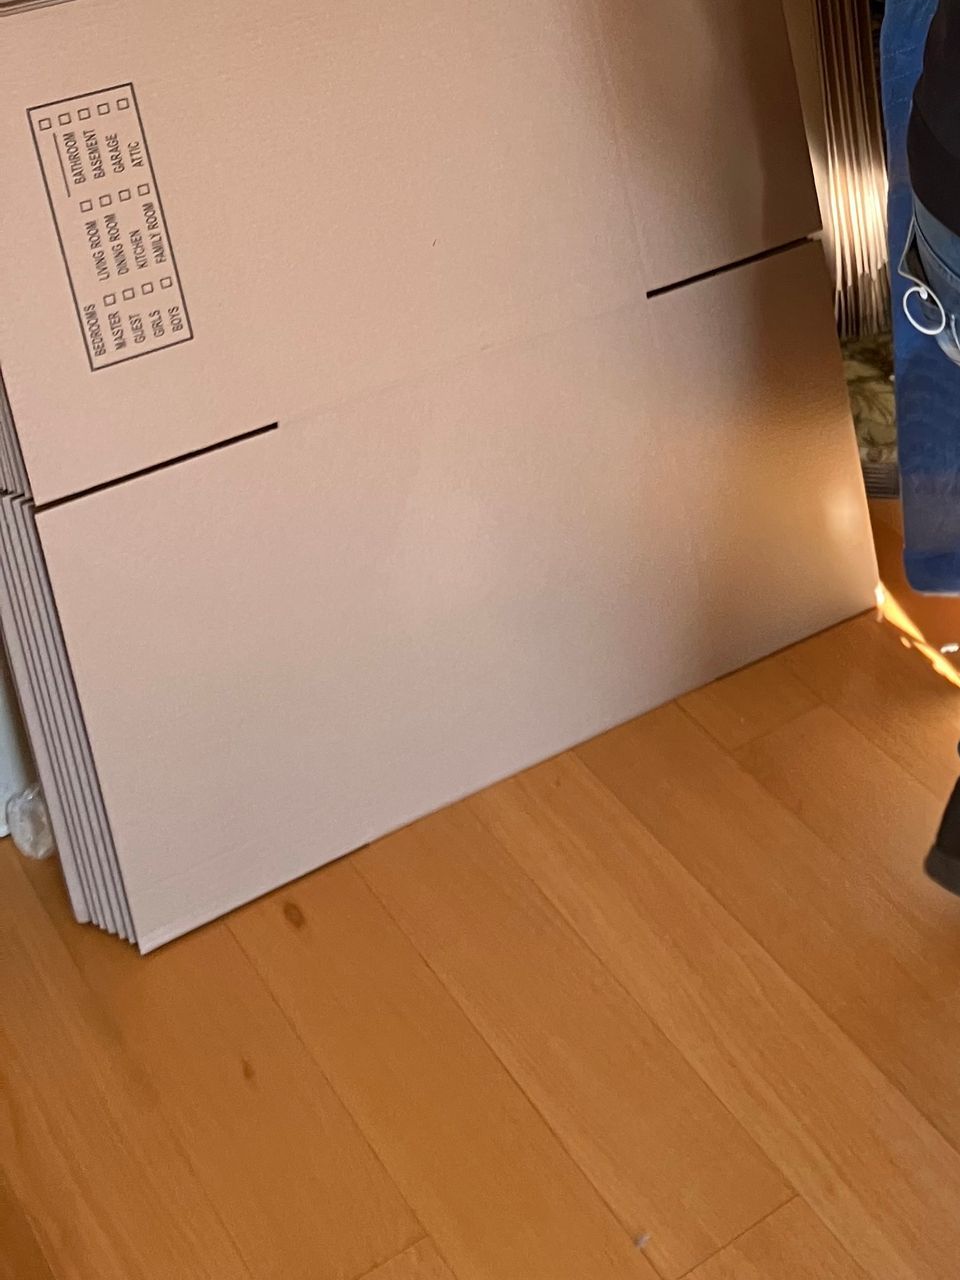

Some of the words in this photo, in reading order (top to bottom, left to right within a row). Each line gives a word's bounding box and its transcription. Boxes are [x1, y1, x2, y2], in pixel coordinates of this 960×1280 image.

[63, 132, 85, 184] BATHROOM
[83, 129, 105, 180] BASEMENT
[105, 133, 125, 173] GARAGE
[127, 140, 144, 168] ATTIC
[104, 214, 121, 241] ROOM
[142, 202, 160, 229] ROOM
[85, 220, 102, 249] ROOM
[129, 229, 149, 269] KITCHEN
[150, 231, 167, 264] FAMILY
[93, 248, 110, 281] LIVING
[110, 241, 129, 275] DINING
[84, 303, 106, 357] BEDROOMS
[107, 311, 127, 352] MASTER
[128, 312, 146, 344] GUEST
[147, 309, 165, 338] GIRLS
[168, 306, 183, 333] BOYS
